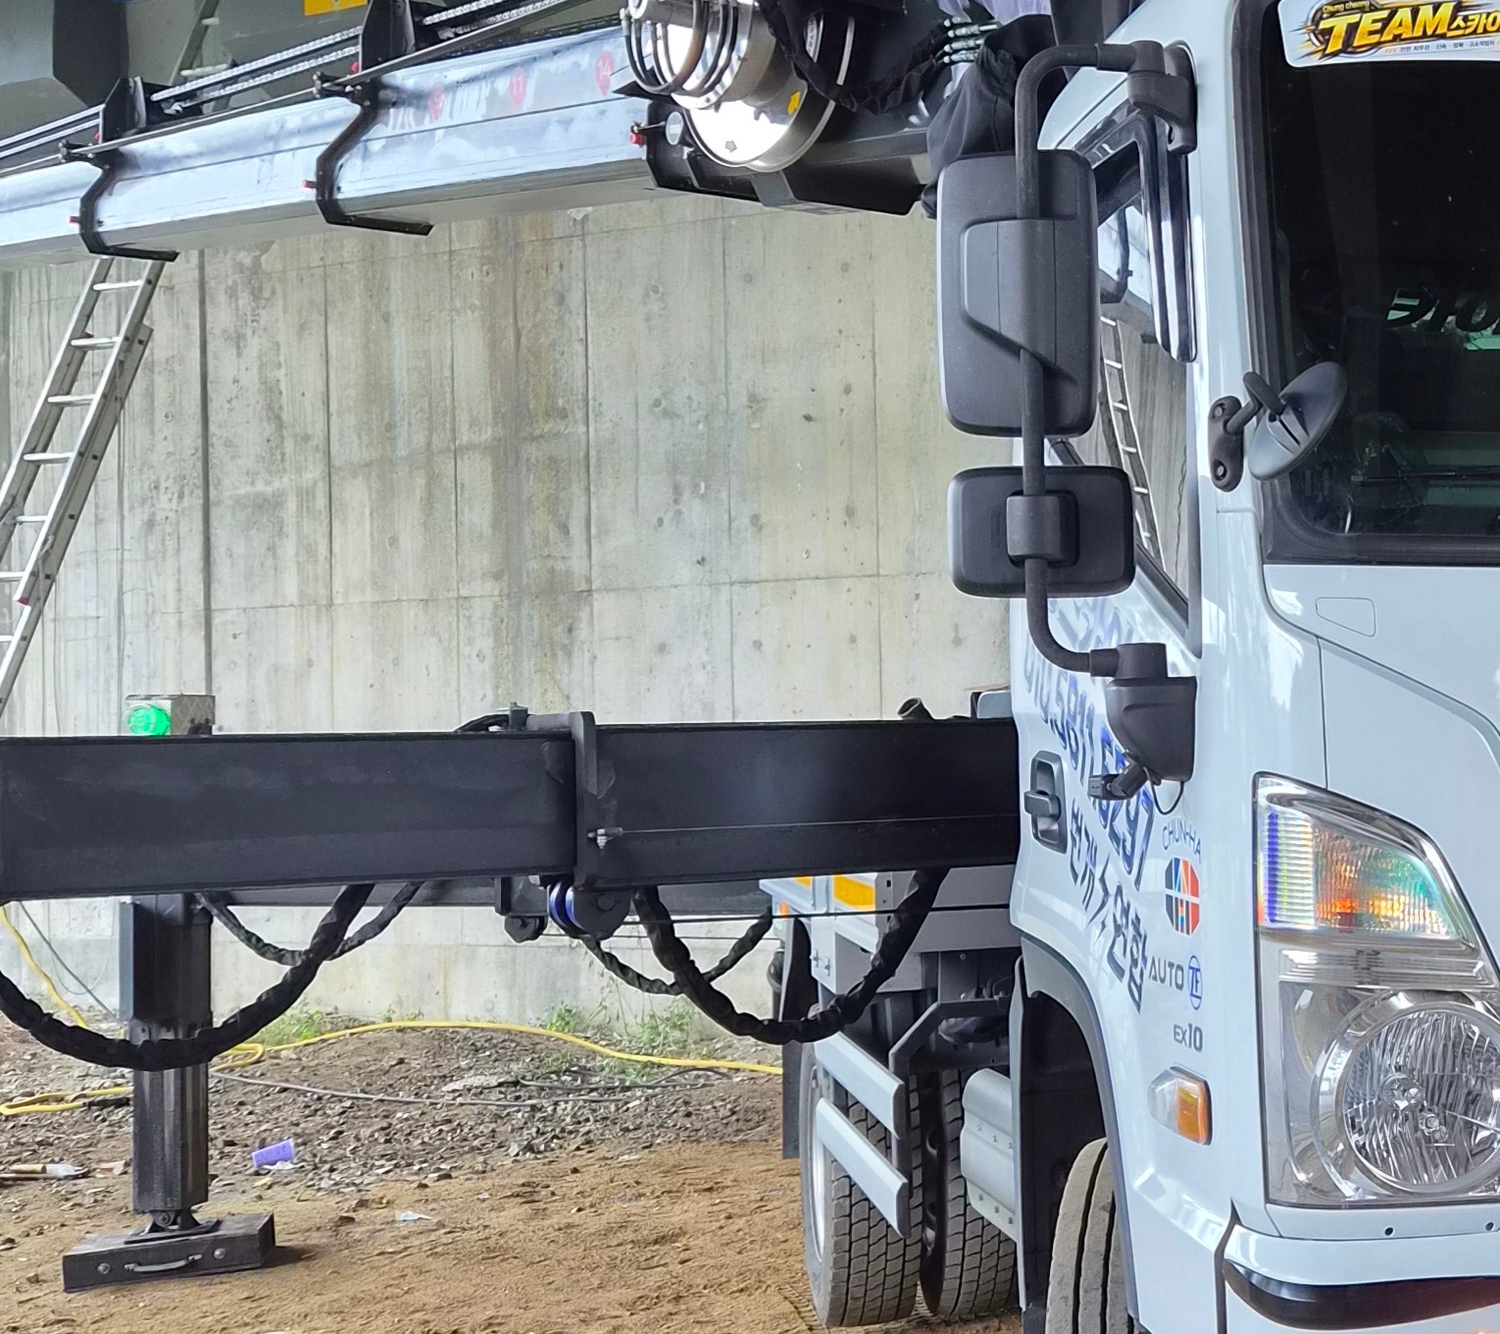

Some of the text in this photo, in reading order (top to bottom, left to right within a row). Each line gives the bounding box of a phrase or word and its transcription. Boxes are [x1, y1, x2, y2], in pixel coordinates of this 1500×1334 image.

[1318, 0, 1459, 55] TEAM
[511, 76, 525, 95] 11
[597, 59, 612, 78] 14
[1069, 796, 1150, 1015] 번개 연합
[1148, 954, 1202, 1002] AUTO ZF
